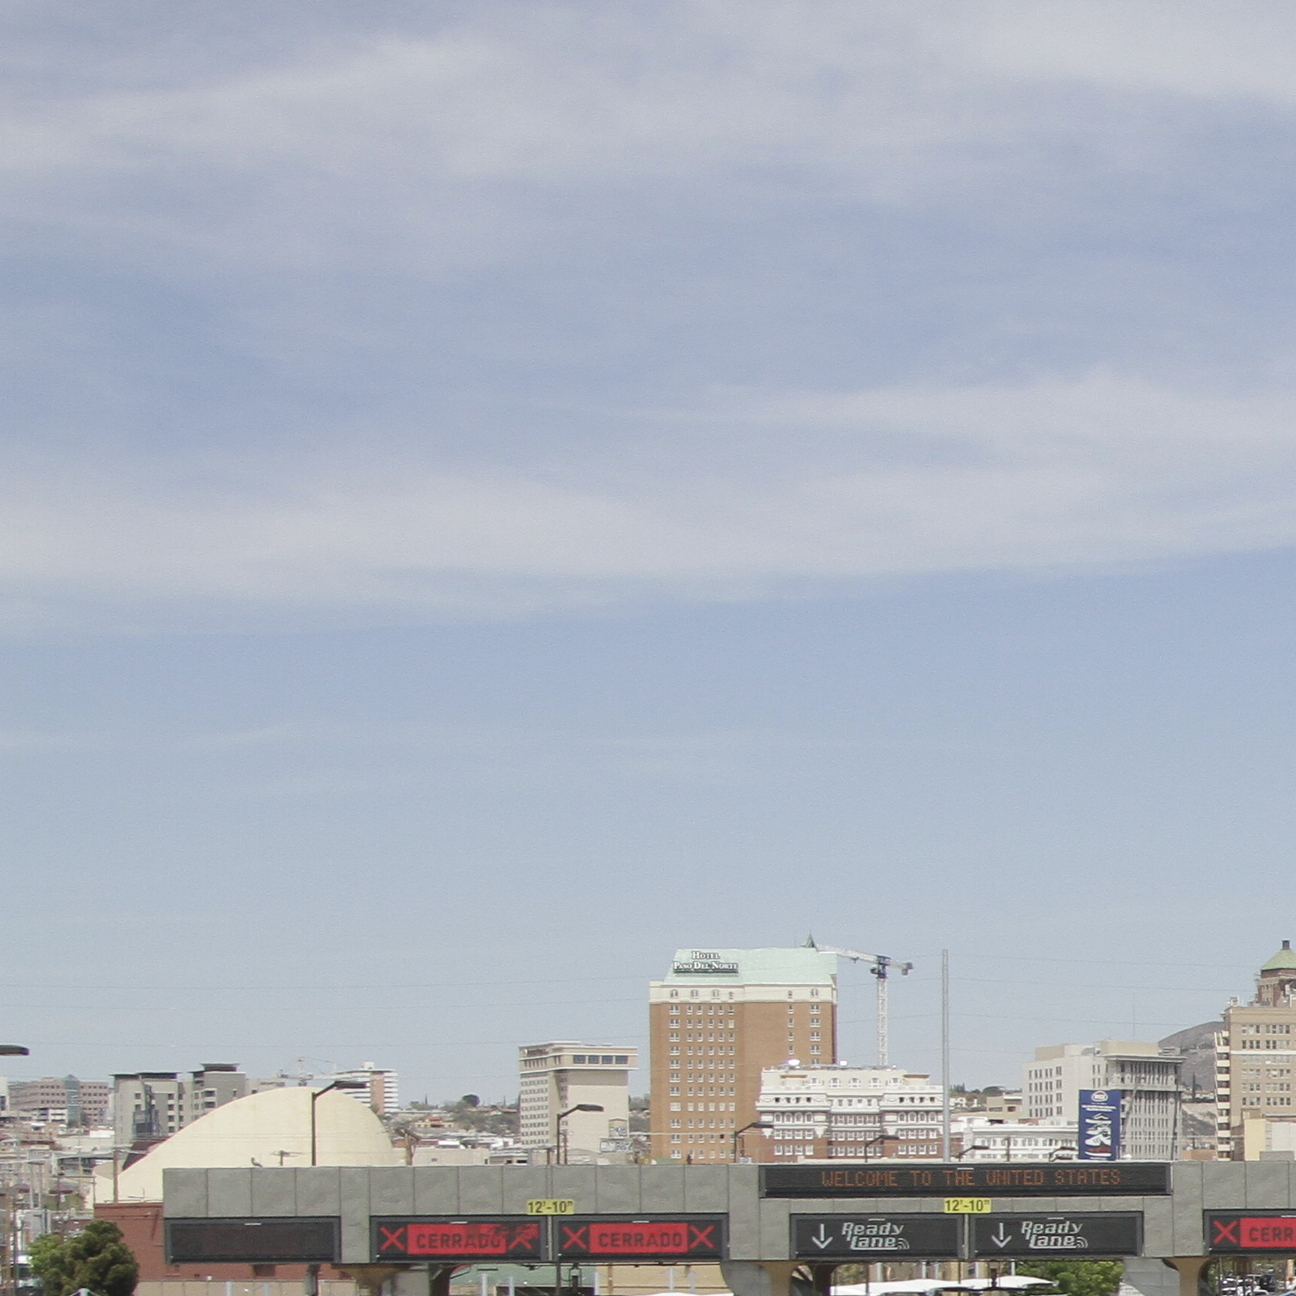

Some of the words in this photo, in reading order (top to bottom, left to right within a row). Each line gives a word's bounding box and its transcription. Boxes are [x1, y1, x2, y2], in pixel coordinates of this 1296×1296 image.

[822, 1170, 898, 1187] WELCOME
[909, 1170, 929, 1186] TO
[943, 1170, 975, 1186] THE
[986, 1169, 1044, 1186] UNITED
[1055, 1169, 1121, 1185] STATES
[842, 1221, 904, 1241] Ready
[1021, 1221, 1083, 1241] Ready
[598, 1233, 682, 1247] CERRADO
[851, 1235, 898, 1251] Lane
[1030, 1235, 1077, 1250] Lane
